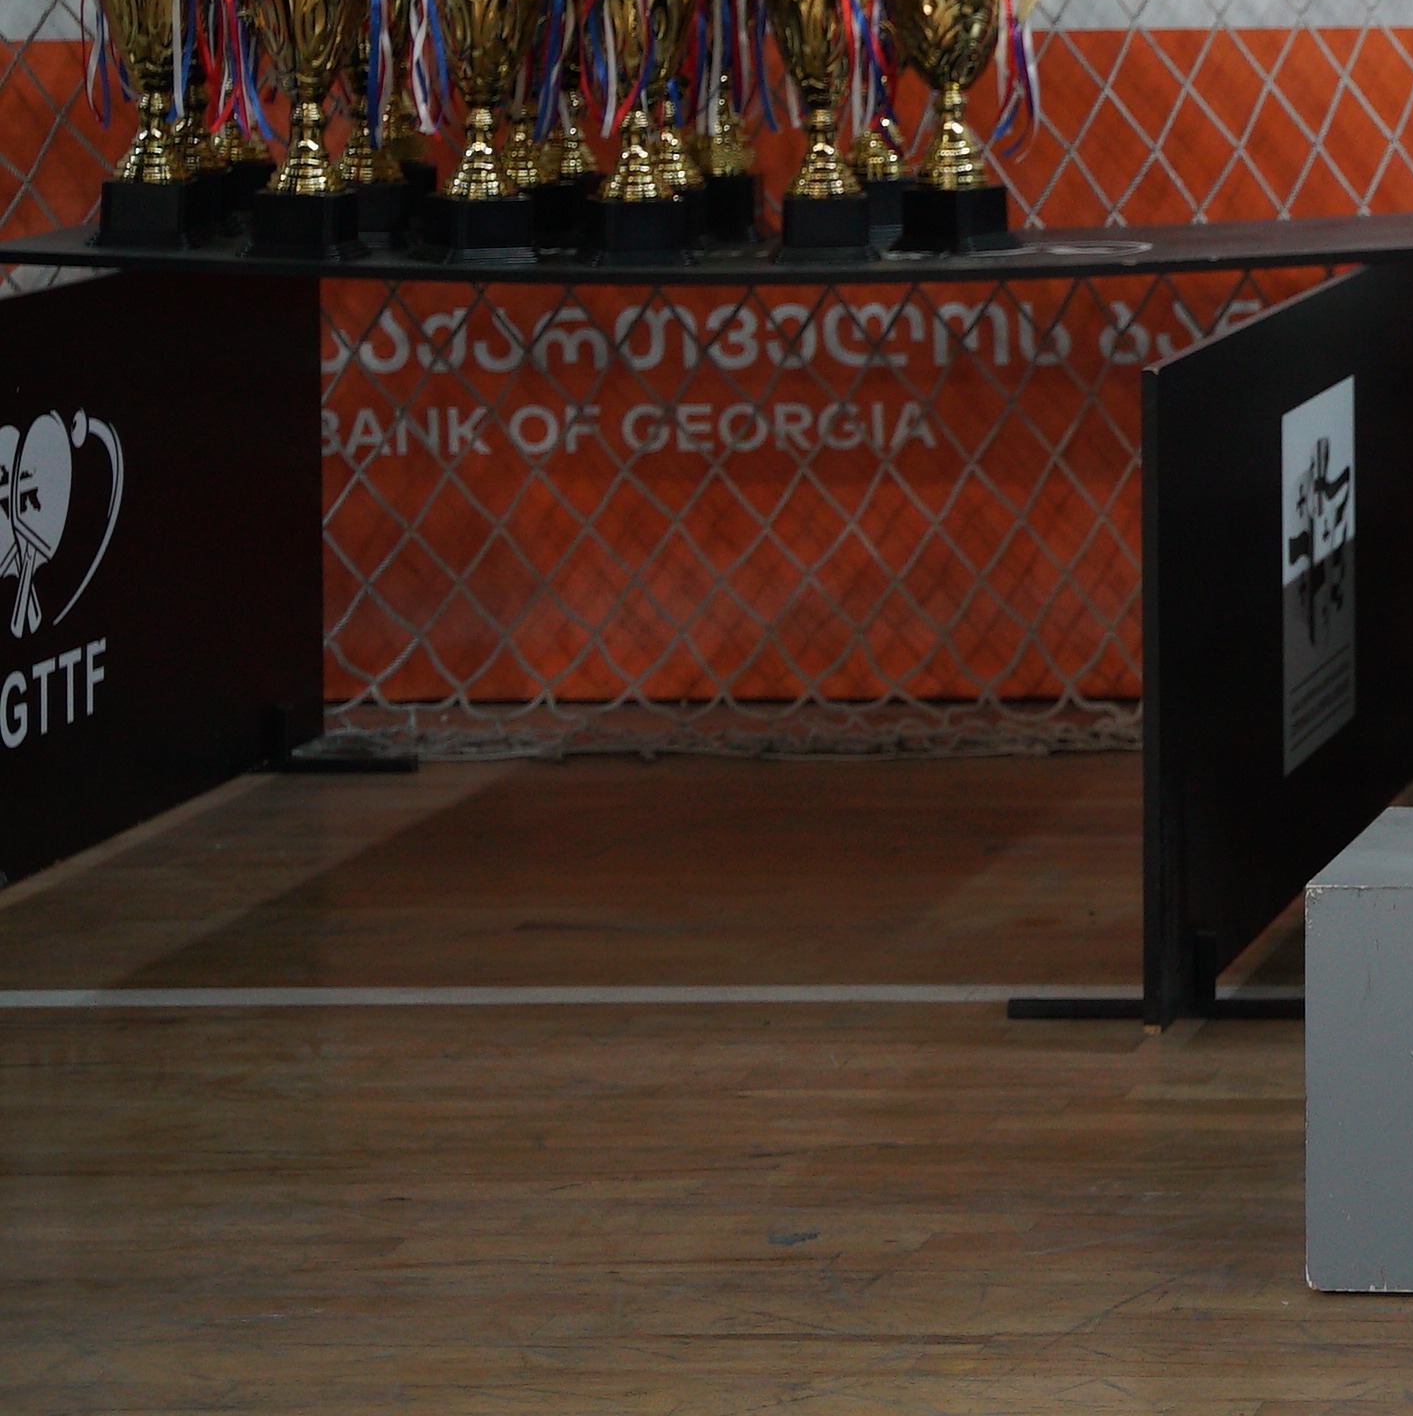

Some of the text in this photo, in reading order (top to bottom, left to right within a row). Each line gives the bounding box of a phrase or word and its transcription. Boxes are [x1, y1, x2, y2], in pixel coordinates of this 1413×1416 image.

[507, 404, 602, 455] OF
[619, 401, 936, 454] GEORGIA
[0, 637, 107, 749] GTTF
